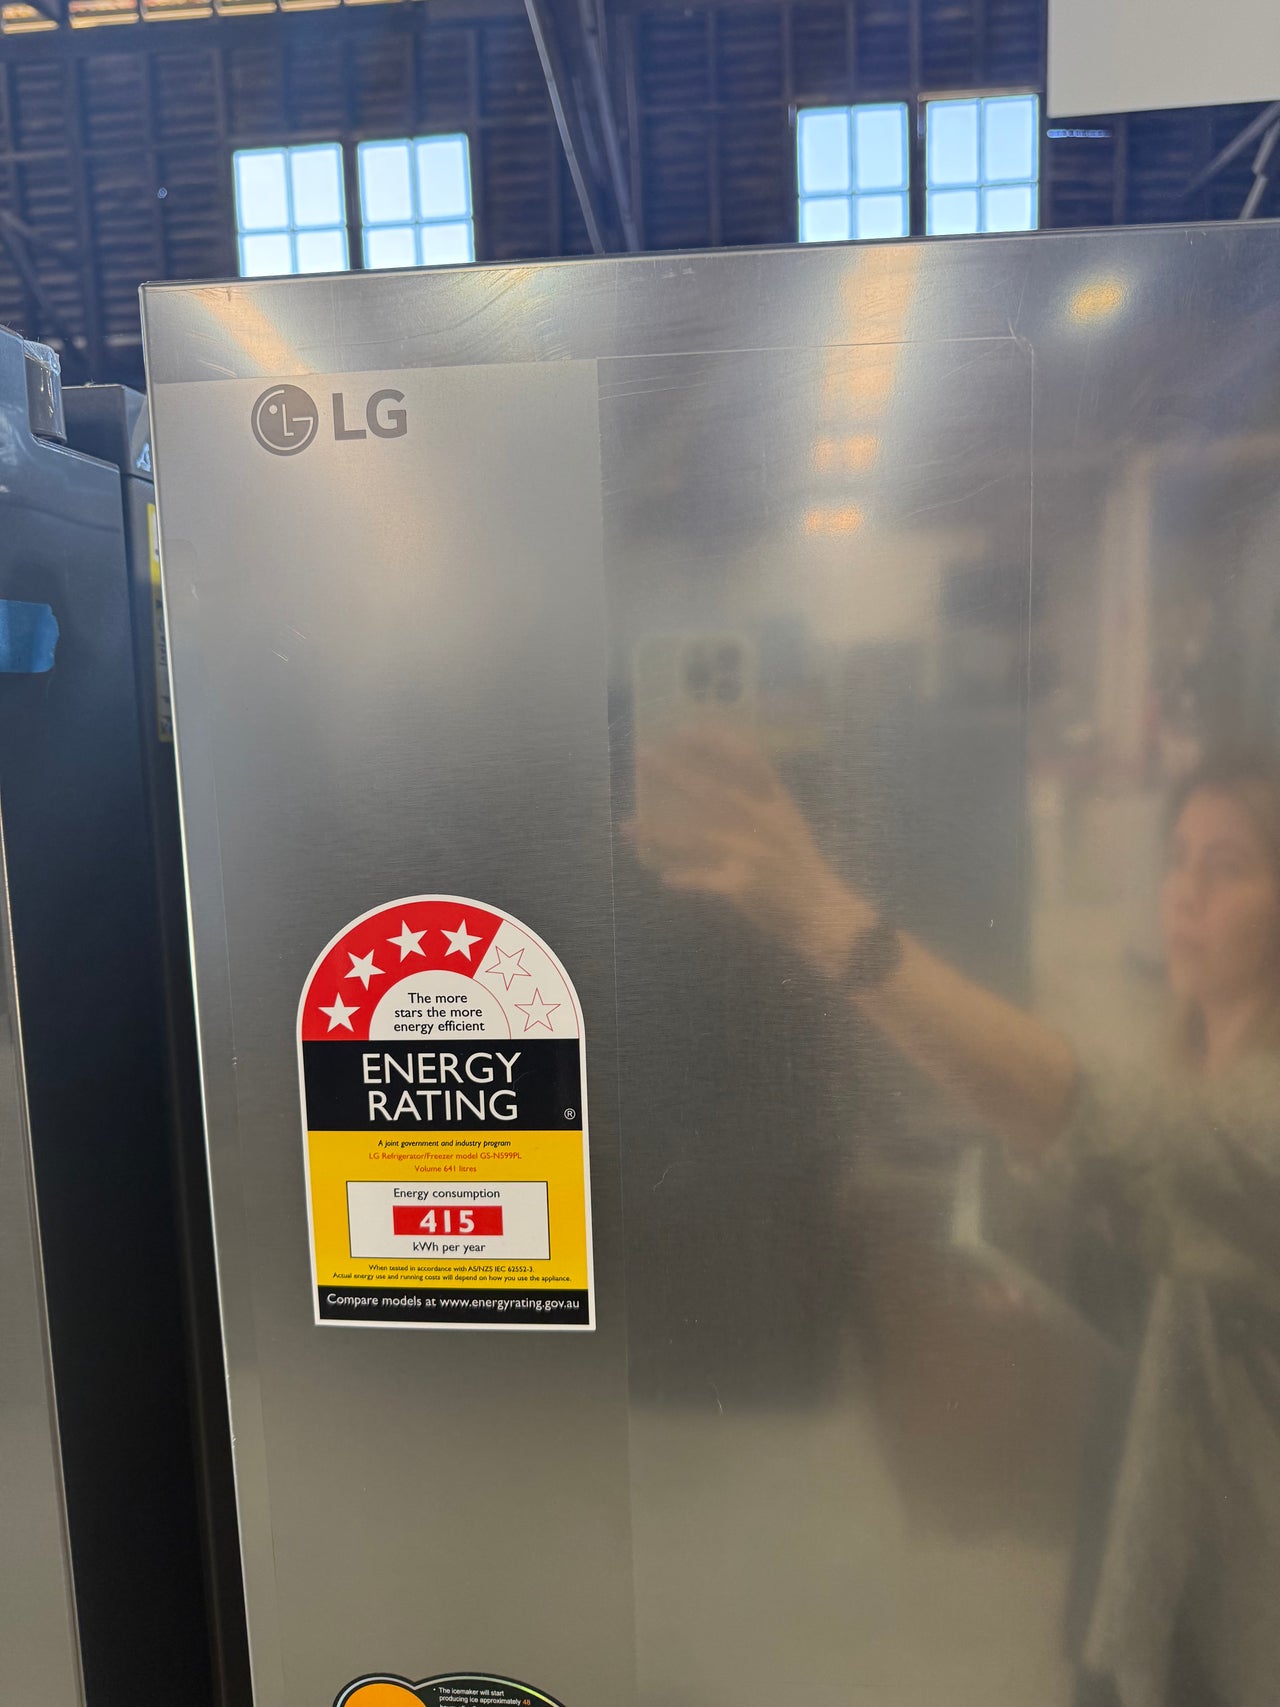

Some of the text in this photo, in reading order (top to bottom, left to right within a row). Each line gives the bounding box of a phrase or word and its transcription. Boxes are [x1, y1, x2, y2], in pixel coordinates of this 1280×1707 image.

[332, 389, 408, 441] LG
[408, 992, 468, 1004] The more
[394, 1006, 483, 1018] stars the more
[393, 1020, 486, 1035] energy efficient
[362, 1052, 522, 1084] ENERGY
[368, 1089, 518, 1122] RATING
[377, 1139, 512, 1148] A joint government and industry program
[368, 1152, 380, 1160] LG
[381, 1152, 454, 1161] Refrigerator/Freezer
[455, 1152, 478, 1160] model
[414, 1164, 477, 1173] Volume 641 litres
[393, 1187, 501, 1201] Energy consumption
[419, 1209, 475, 1233] 415
[413, 1241, 486, 1254] kWh per year
[400, 1273, 424, 1281] running
[541, 1275, 572, 1283] appliance.
[327, 1293, 580, 1311] Compare models at www.energyrating.gov.au
[439, 1696, 469, 1704] producing
[480, 1697, 521, 1706] approximately
